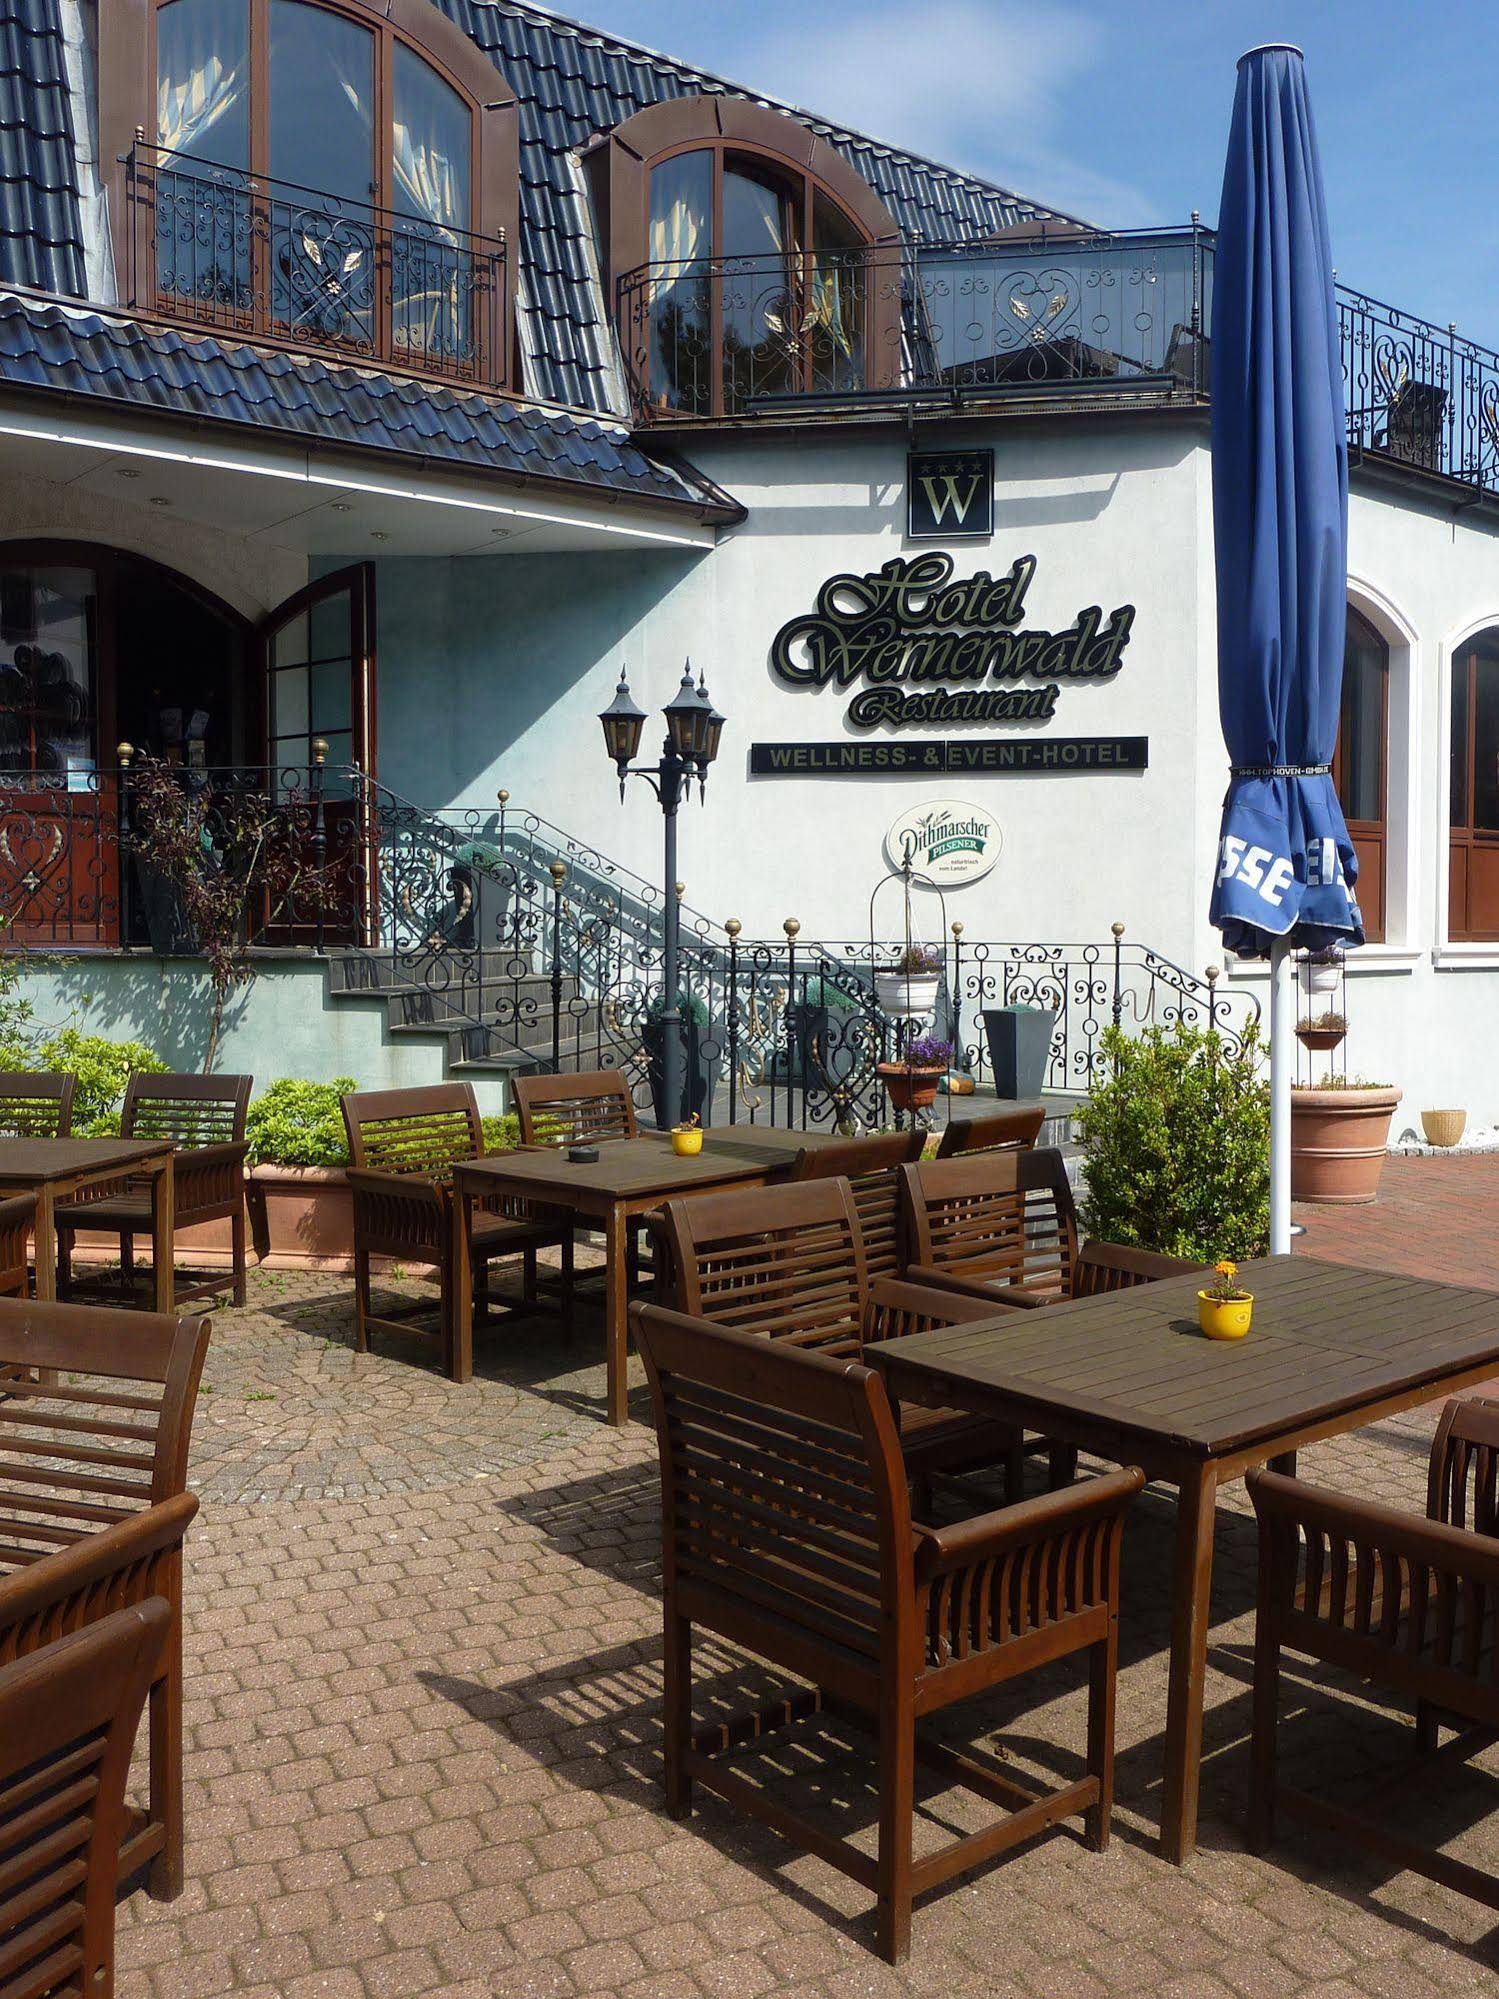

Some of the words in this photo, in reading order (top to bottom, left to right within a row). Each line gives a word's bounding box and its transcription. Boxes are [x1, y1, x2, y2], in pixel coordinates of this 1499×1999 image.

[918, 475, 984, 525] W
[823, 556, 1034, 628] Hotel
[777, 611, 1134, 681] Wernerwald
[852, 688, 1059, 723] Restaurant
[770, 748, 916, 767] WELLNESS-
[923, 748, 939, 765] &
[950, 744, 1129, 765] EVENT-HOTEL
[932, 840, 978, 859] PILSENER
[1218, 836, 1294, 907] SSE
